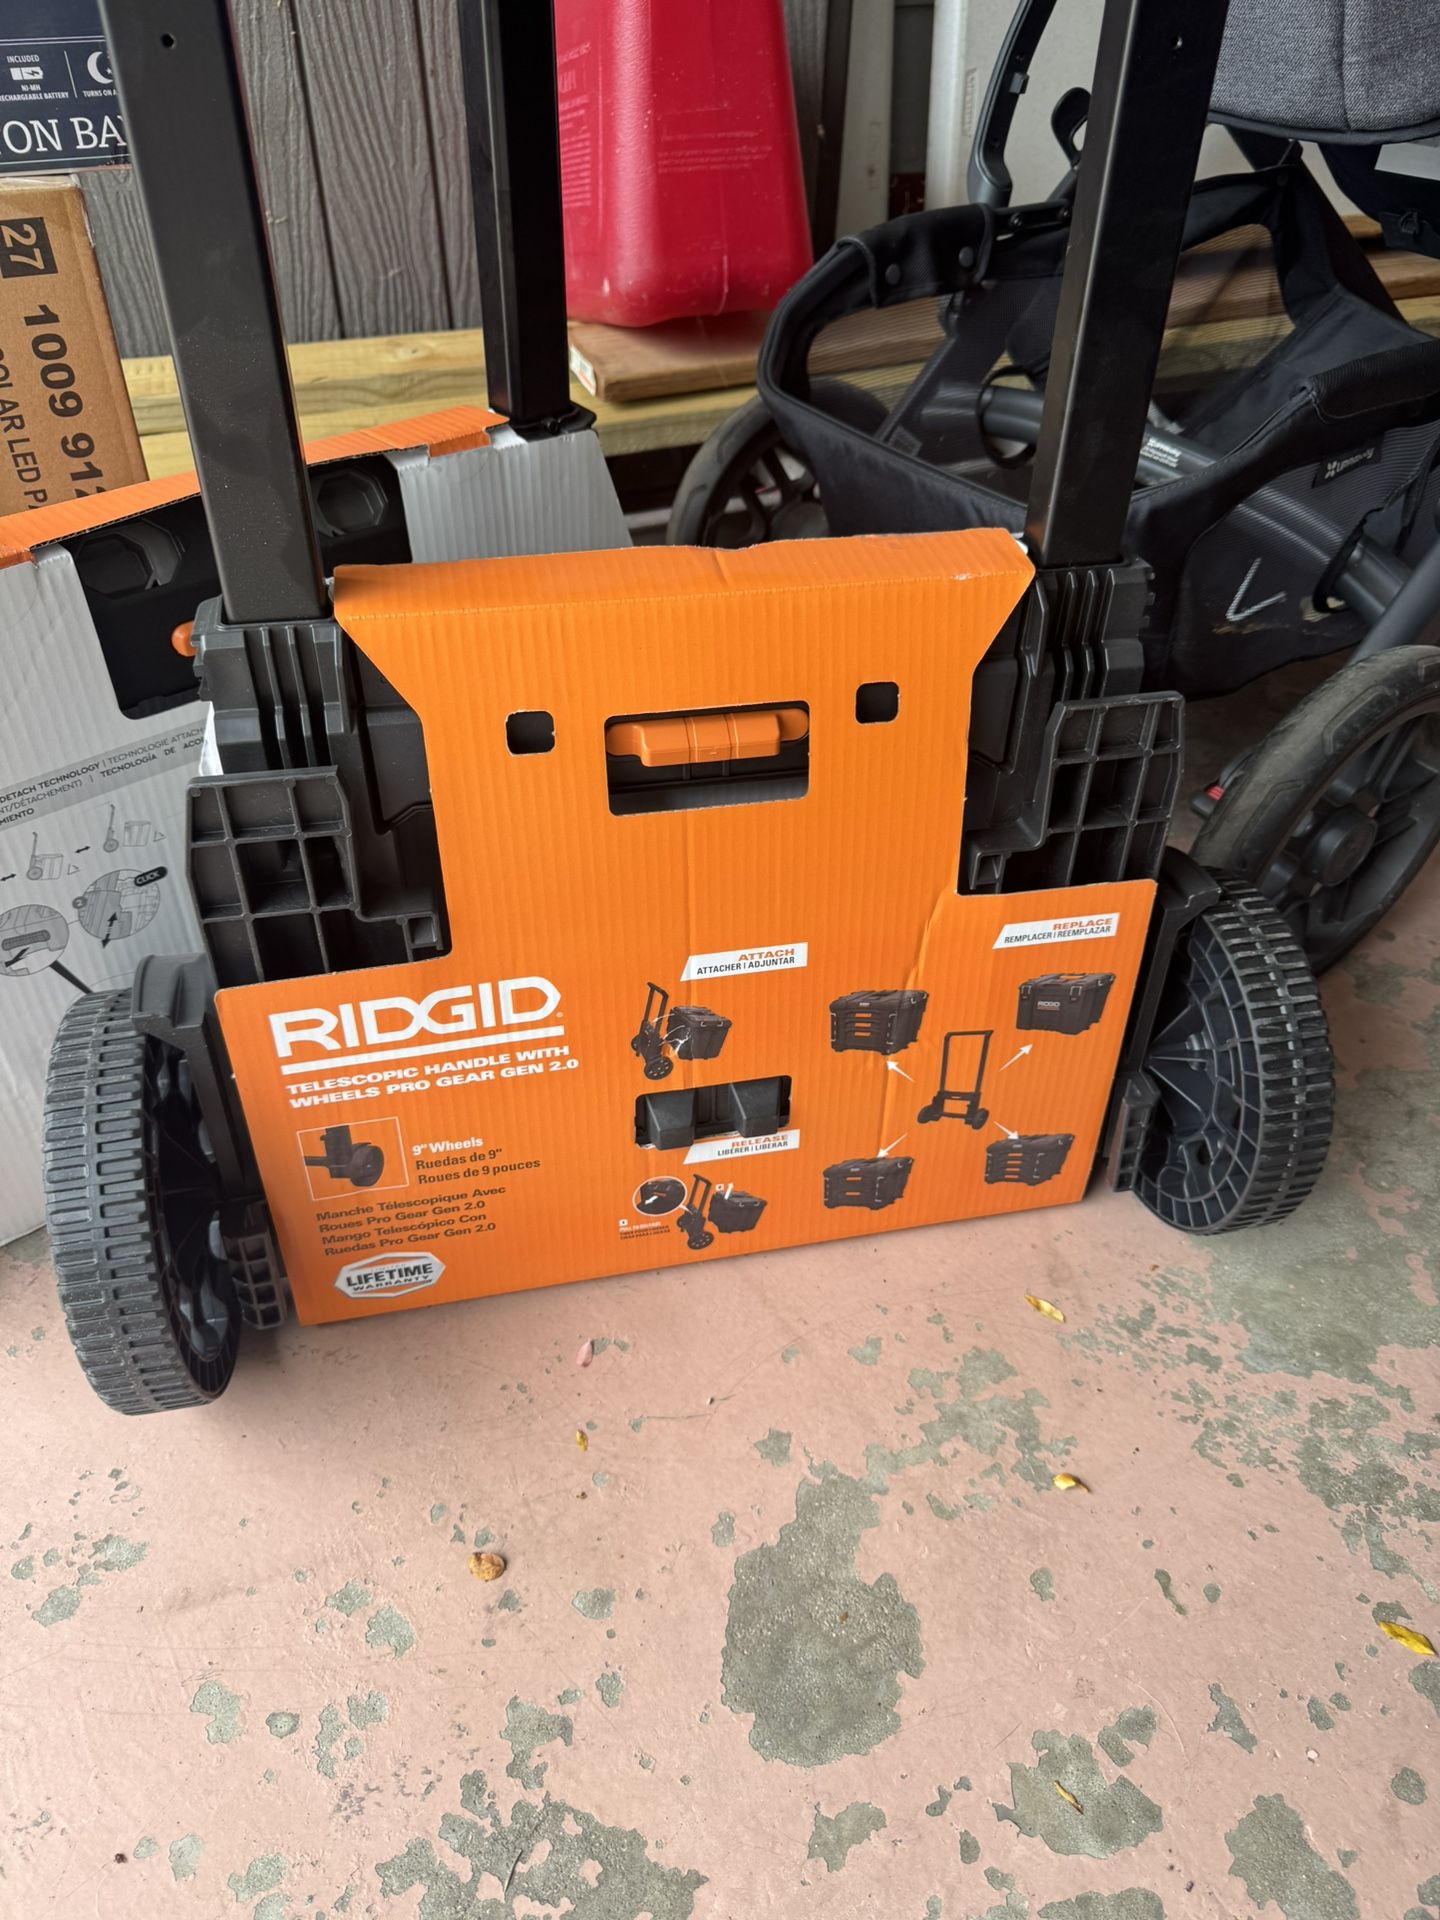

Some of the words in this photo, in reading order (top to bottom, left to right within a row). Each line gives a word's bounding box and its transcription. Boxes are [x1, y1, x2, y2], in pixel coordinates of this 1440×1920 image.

[6, 54, 40, 63] INCLUDED
[43, 91, 69, 100] BATTERY
[1, 223, 45, 270] 27
[23, 304, 83, 417] 1009
[7, 438, 41, 482] LED
[0, 785, 36, 803] DETACH
[37, 762, 99, 789] TECHNOLOGY
[107, 738, 169, 764] TECHNOLOGIE
[100, 753, 157, 777] TECNOLOGÍA
[164, 746, 176, 756] DE
[1004, 932, 1052, 943] REMPLACER
[1057, 925, 1111, 938] REEMPLAZAR
[1053, 918, 1113, 930] REPLACE
[697, 962, 742, 975] ATTACHER
[748, 957, 795, 969] ADJUNTAR
[738, 948, 795, 961] ATTACH
[268, 976, 562, 1058] RIDGID
[285, 1067, 419, 1095] TELESCOPIC
[424, 1053, 511, 1075] HANDLE
[516, 1045, 569, 1062] WITH
[289, 1087, 381, 1109] WHEELS
[386, 1080, 431, 1095] PRO
[435, 1070, 495, 1087] GEAR
[500, 1063, 544, 1078] GEN
[549, 1059, 579, 1072] 2.0
[429, 1136, 484, 1153] Wheels
[731, 1135, 788, 1147] RELEASE
[755, 1141, 788, 1151] LIBERAR
[415, 1154, 467, 1170] Ruedas
[469, 1152, 486, 1162] de
[418, 1171, 460, 1185] Roues
[463, 1168, 480, 1178] de
[482, 1165, 490, 1175] 9
[492, 1160, 541, 1176] pouces
[316, 1206, 374, 1221] Manche
[376, 1192, 468, 1211] Télescopique
[472, 1187, 506, 1198] Avec
[319, 1220, 363, 1232] Roues
[366, 1216, 391, 1225] Pro
[395, 1210, 429, 1220] Gear
[432, 1205, 460, 1215] Gen
[464, 1200, 485, 1210] 2.0
[322, 1231, 371, 1245] Mango
[374, 1218, 455, 1236] Telescópico
[459, 1214, 486, 1223] Con
[325, 1243, 376, 1256] Ruedas
[380, 1238, 404, 1247] Pro
[407, 1232, 440, 1242] Gear
[443, 1227, 471, 1237] Gen
[475, 1222, 496, 1232] 2.0
[346, 1263, 433, 1287] LIFETIME
[353, 1275, 430, 1291] WARRANTY
